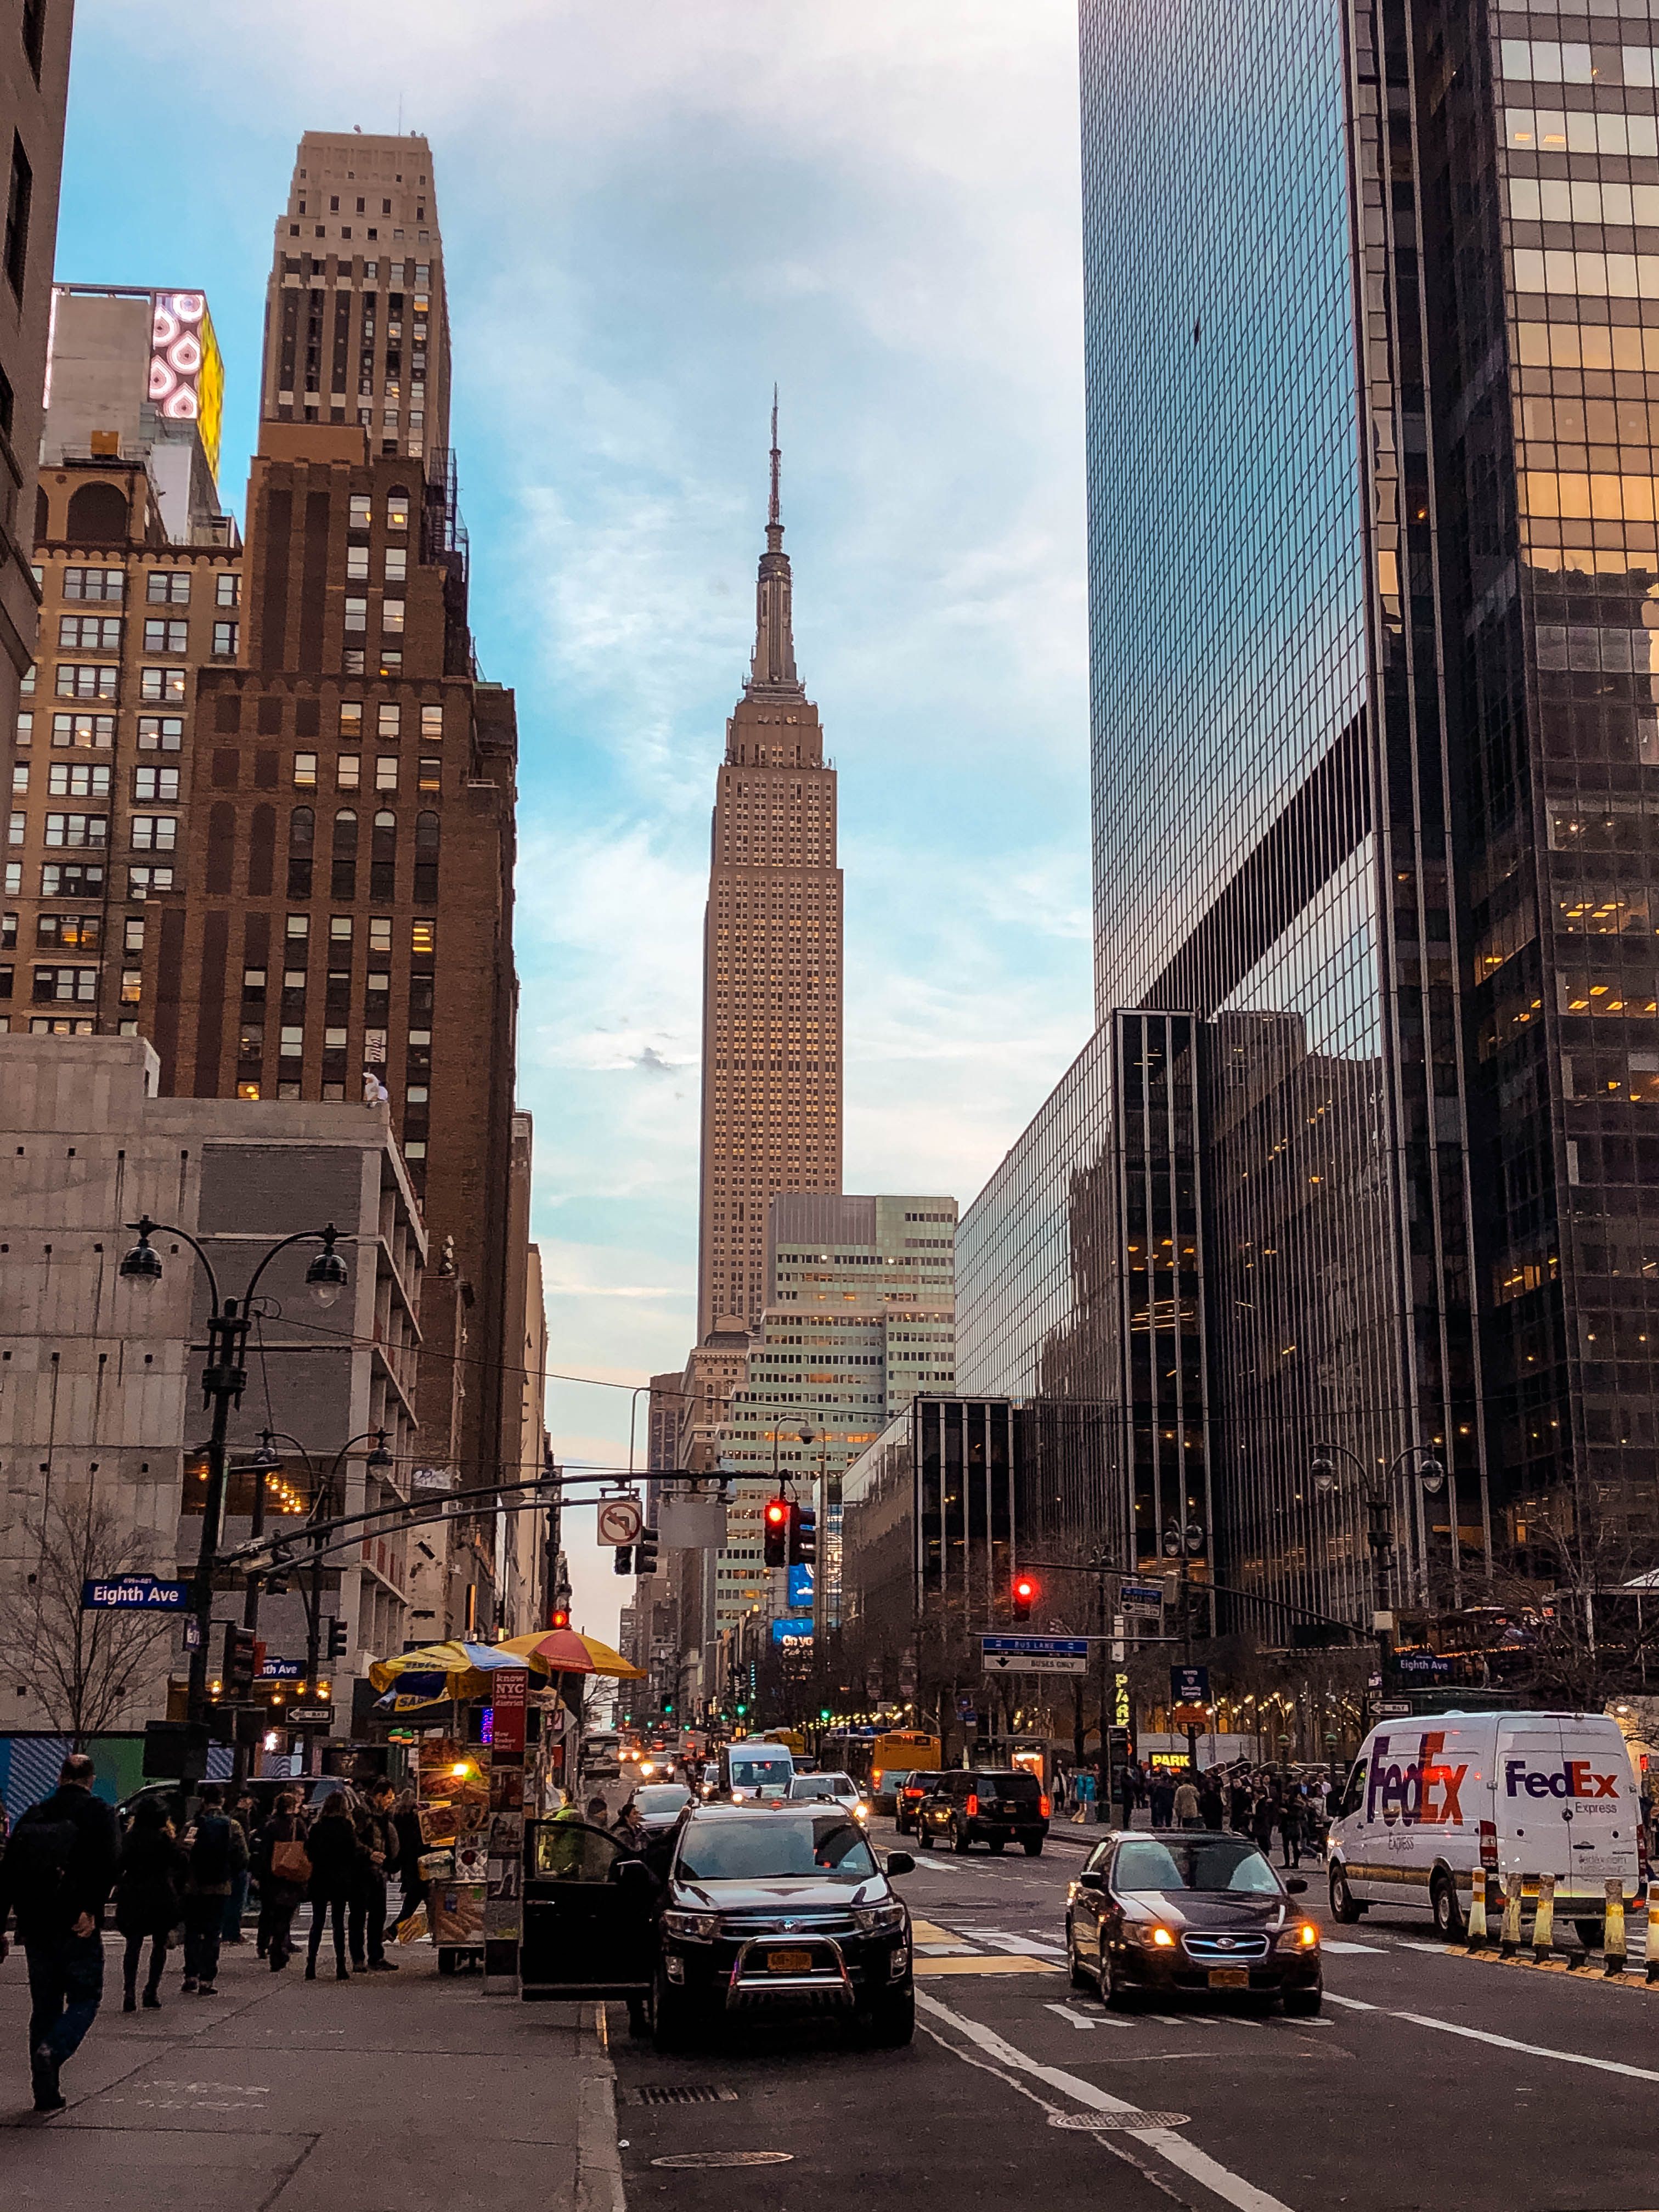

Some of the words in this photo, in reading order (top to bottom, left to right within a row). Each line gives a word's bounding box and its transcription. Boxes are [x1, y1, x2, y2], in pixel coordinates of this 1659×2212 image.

[93, 1586, 143, 1605] Eighth
[148, 1587, 179, 1601] Ave
[278, 1665, 297, 1674] Ave
[1056, 1661, 1075, 1669] ONLY
[1401, 1660, 1429, 1671] Eighth
[1431, 1661, 1448, 1670] Ave
[496, 1674, 525, 1682] know
[496, 1684, 524, 1694] NYC
[1152, 1754, 1190, 1767] PARK
[1367, 1732, 1469, 1827] FedEx
[1505, 1760, 1620, 1798] FedEx
[1575, 1802, 1617, 1815] Express
[1389, 1830, 1414, 1854] Express
